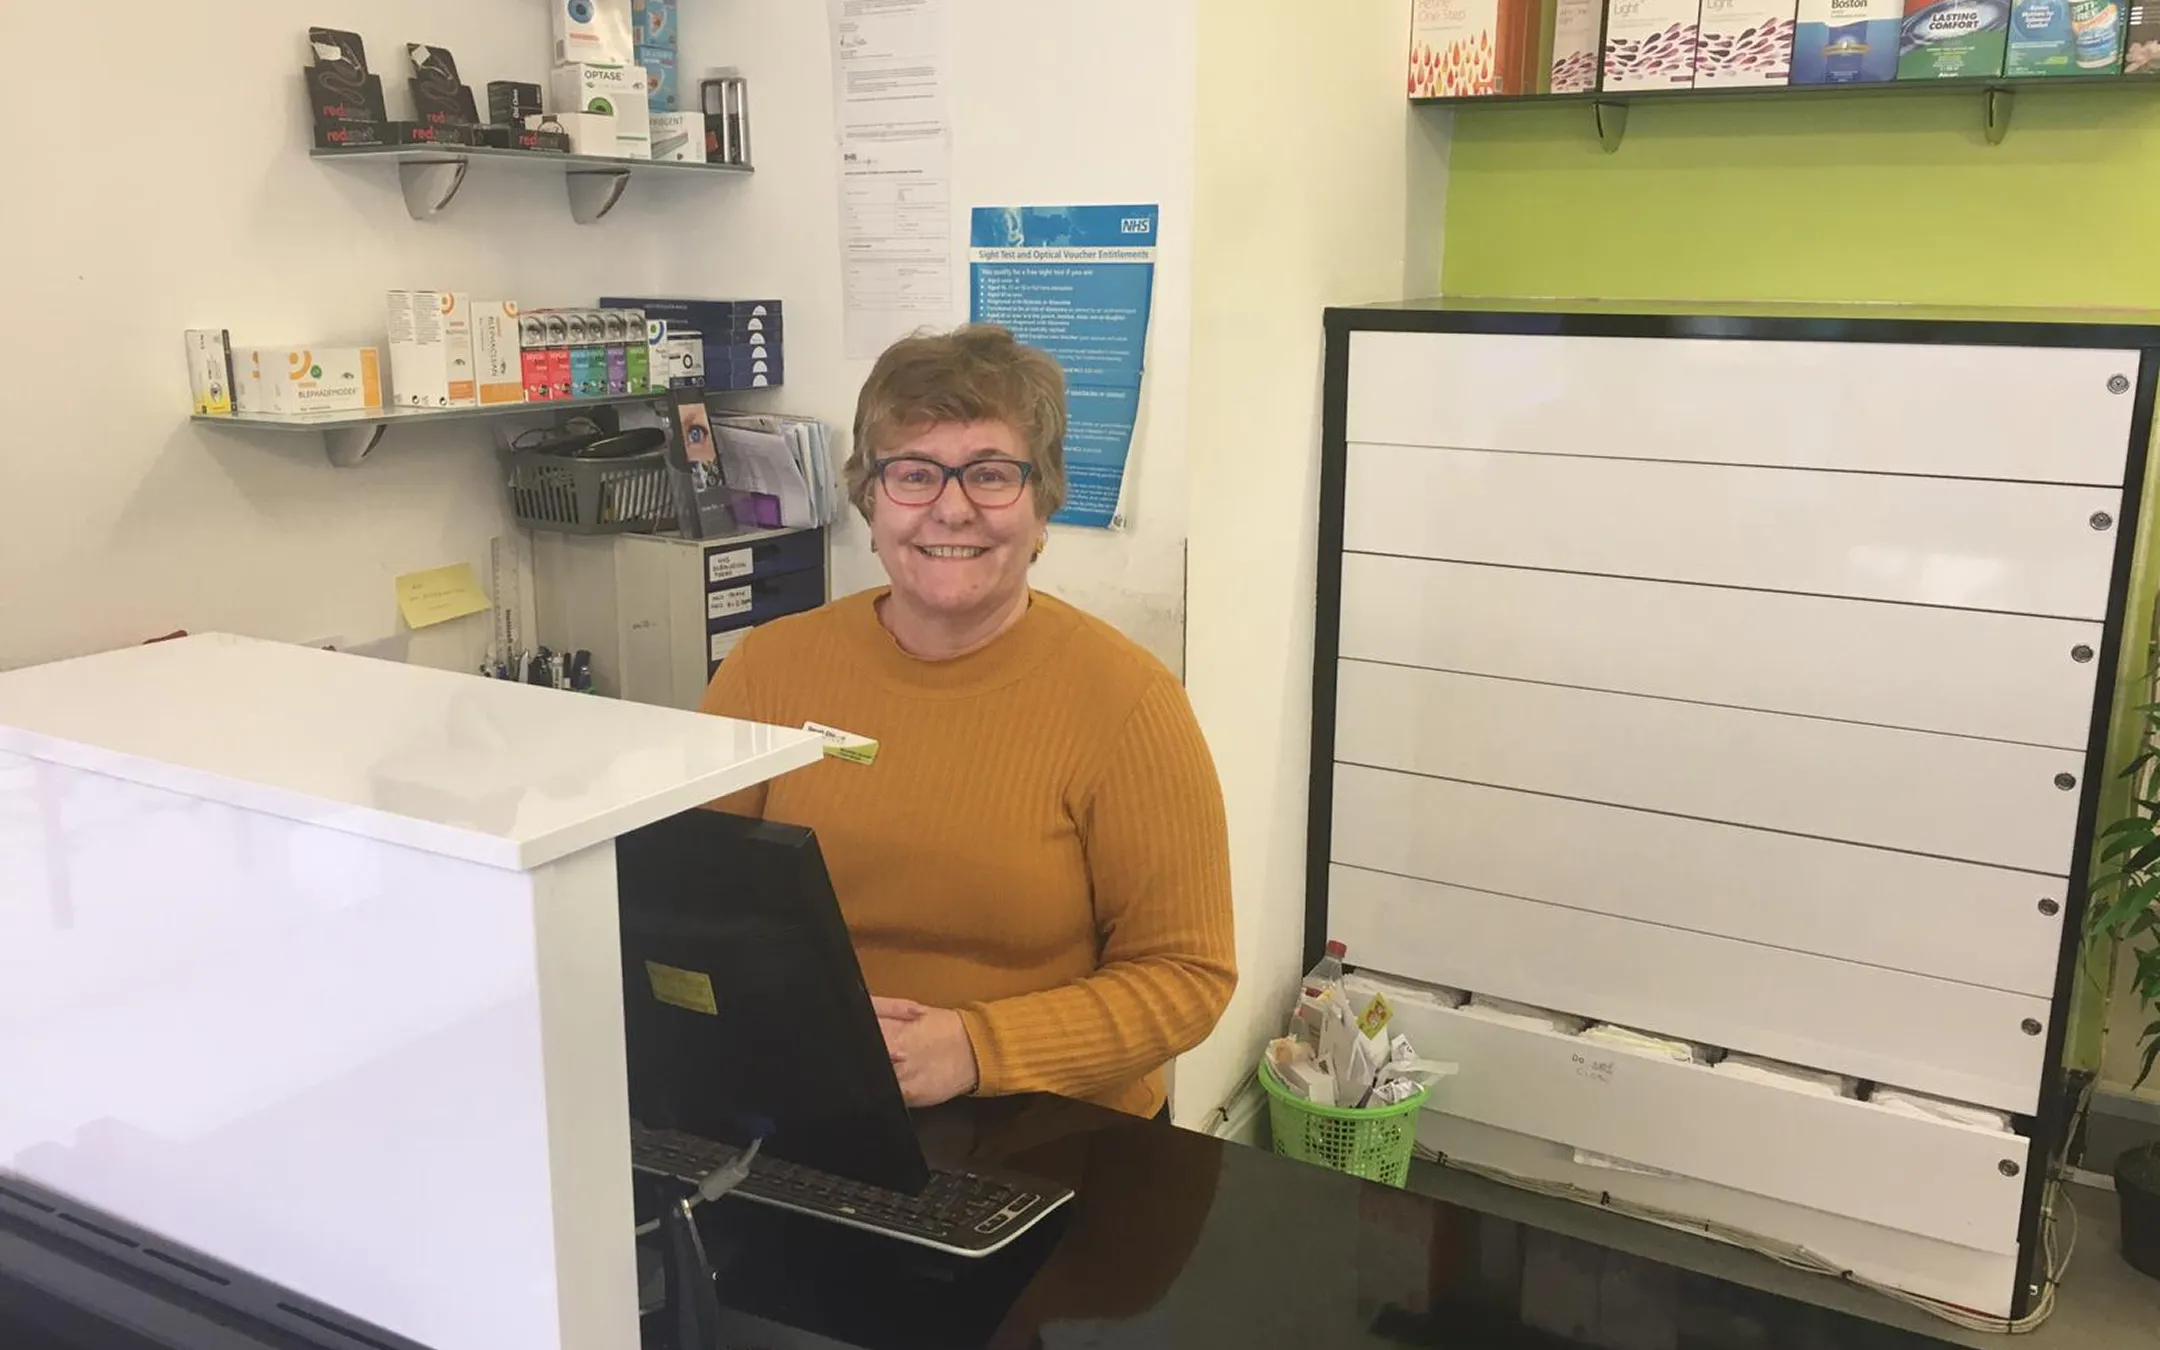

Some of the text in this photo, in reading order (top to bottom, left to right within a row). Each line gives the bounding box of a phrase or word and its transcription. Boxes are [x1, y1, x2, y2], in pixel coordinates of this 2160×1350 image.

[1932, 12, 1978, 22] LASTING
[1929, 20, 1980, 30] COMFORT
[585, 70, 621, 81] OPTASE
[1122, 220, 1149, 231] NHS
[979, 250, 1149, 260] Sight Test and Optical Voucher Entitlements
